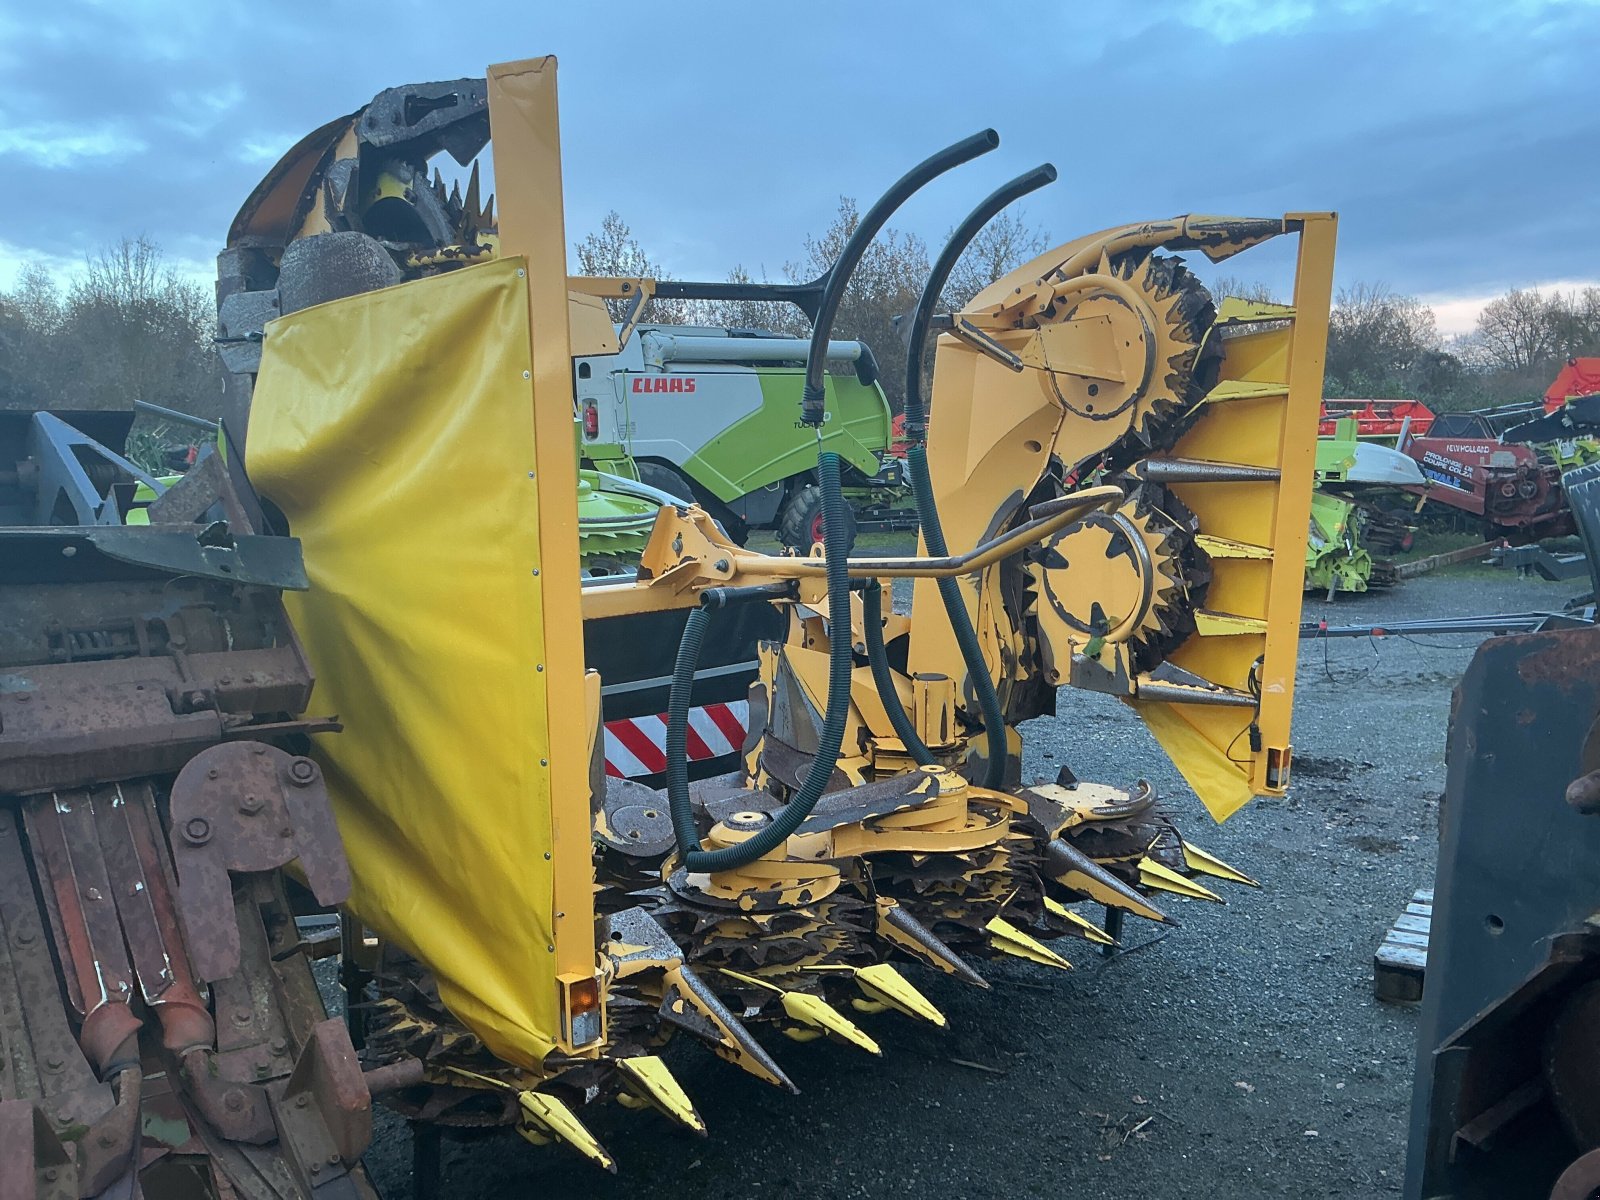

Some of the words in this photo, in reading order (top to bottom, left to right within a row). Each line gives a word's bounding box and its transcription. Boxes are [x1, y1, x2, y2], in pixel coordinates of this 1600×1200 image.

[632, 378, 696, 392] CLAAS
[1446, 444, 1460, 452] NEW
[1460, 445, 1490, 453] HOLLAND
[1423, 456, 1447, 469] COUPE
[1449, 465, 1472, 479] COLZA
